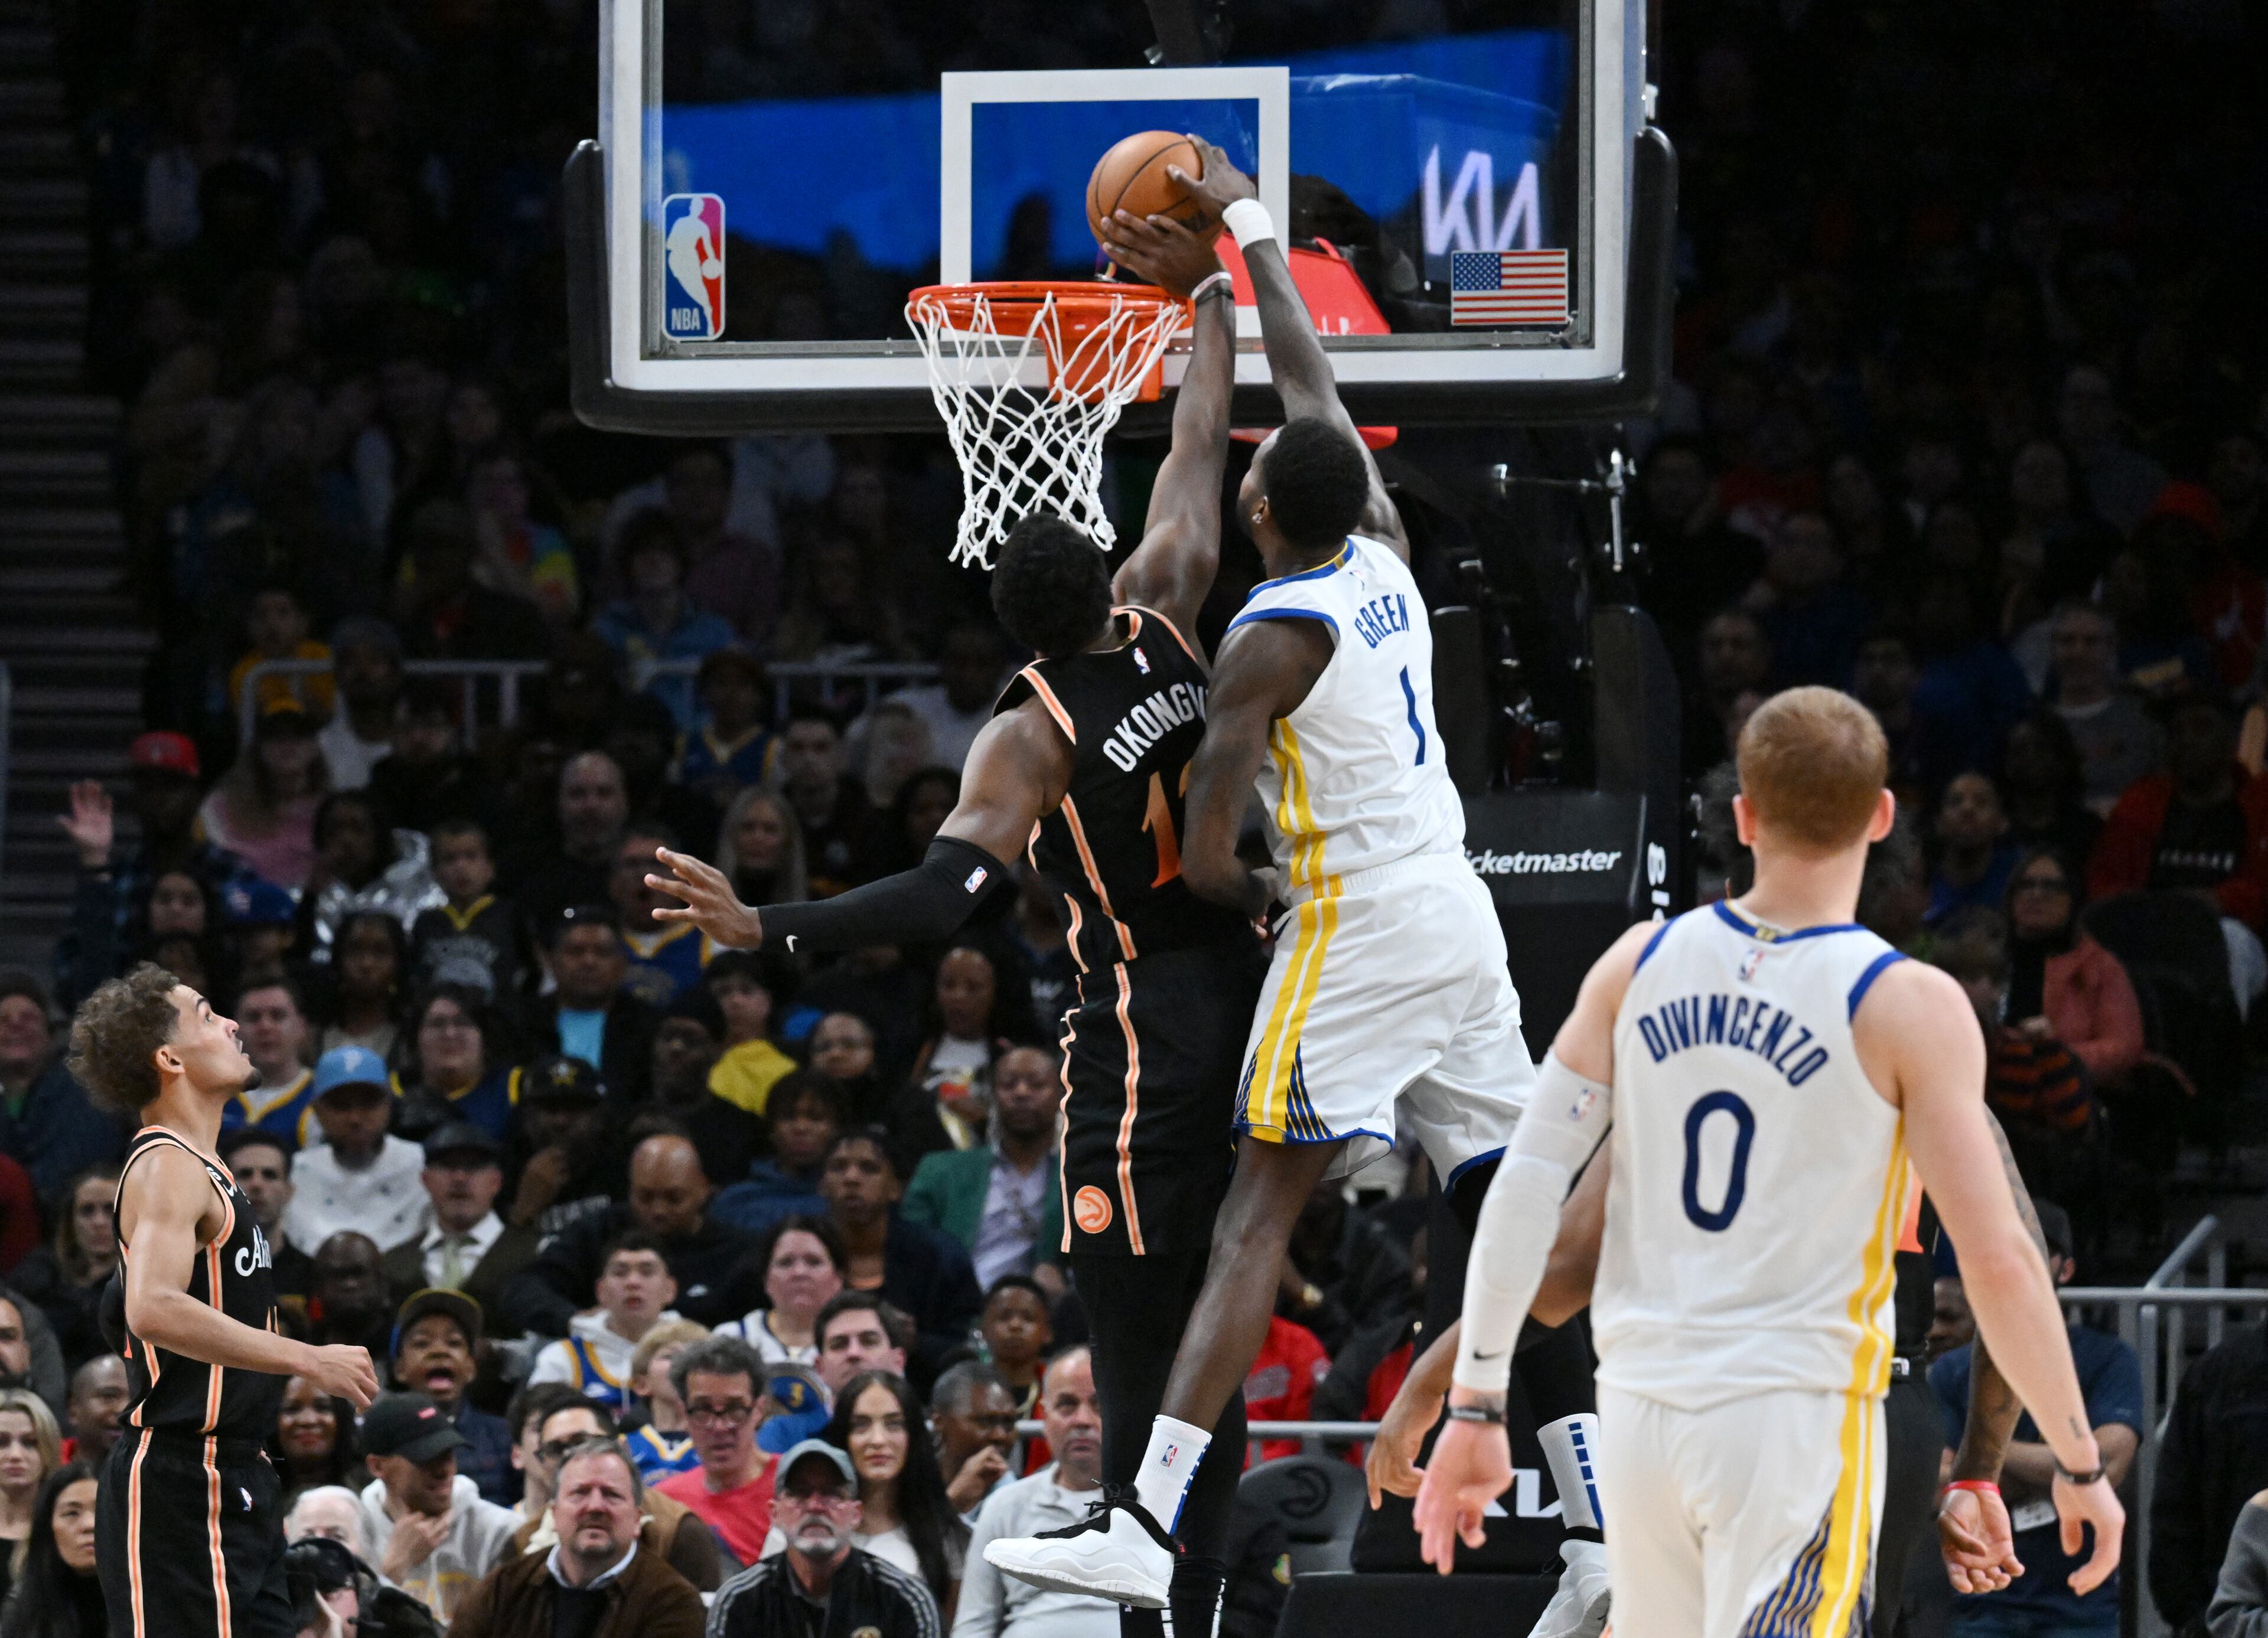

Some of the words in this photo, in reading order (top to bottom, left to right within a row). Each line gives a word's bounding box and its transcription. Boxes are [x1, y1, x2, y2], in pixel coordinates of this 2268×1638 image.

[671, 308, 701, 331] NBA
[1355, 593, 1409, 649] GREEN
[1399, 664, 1426, 766] 1
[1465, 849, 1622, 875] cketmaster
[1637, 994, 1829, 1088] DIVINCENZO
[1682, 1089, 1755, 1232] 0
